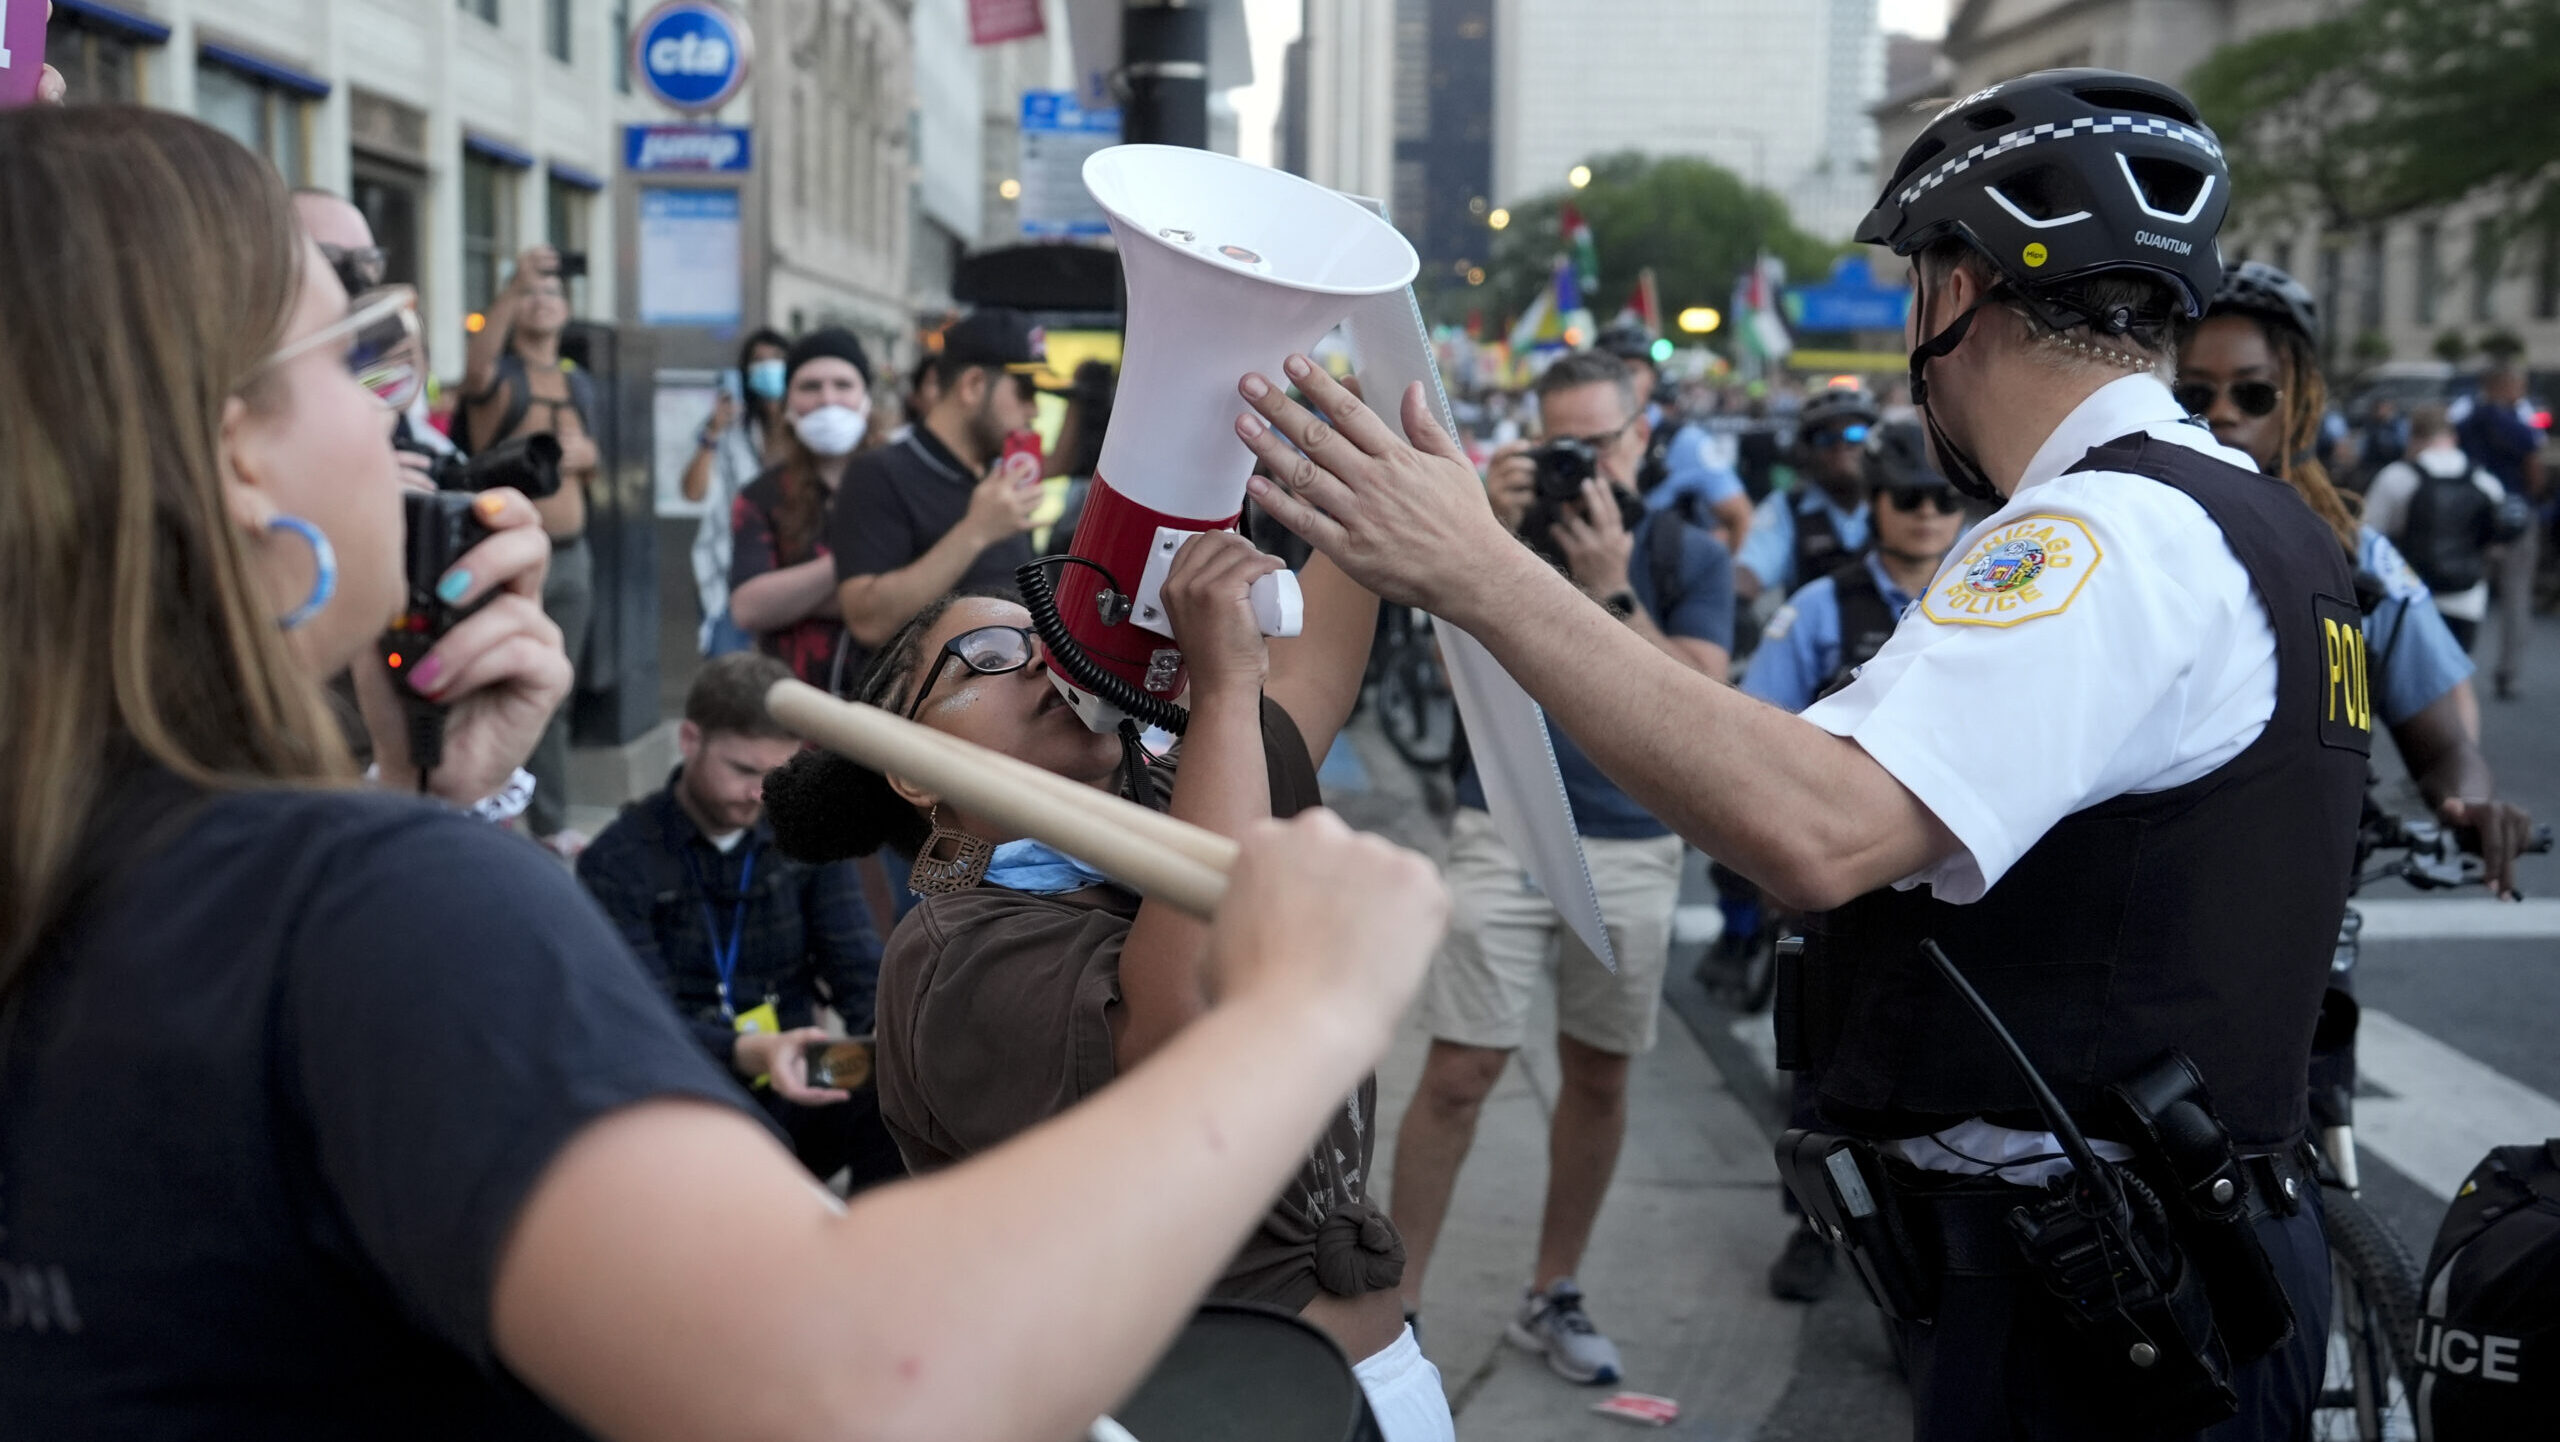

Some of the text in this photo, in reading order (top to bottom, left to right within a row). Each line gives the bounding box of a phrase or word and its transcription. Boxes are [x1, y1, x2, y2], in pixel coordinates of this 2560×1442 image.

[650, 32, 730, 76] cta
[2025, 250, 2045, 260] Mips
[2134, 230, 2193, 256] QUANTUM
[1963, 523, 2073, 569] CHICAGO
[1943, 583, 2044, 614] POLICE
